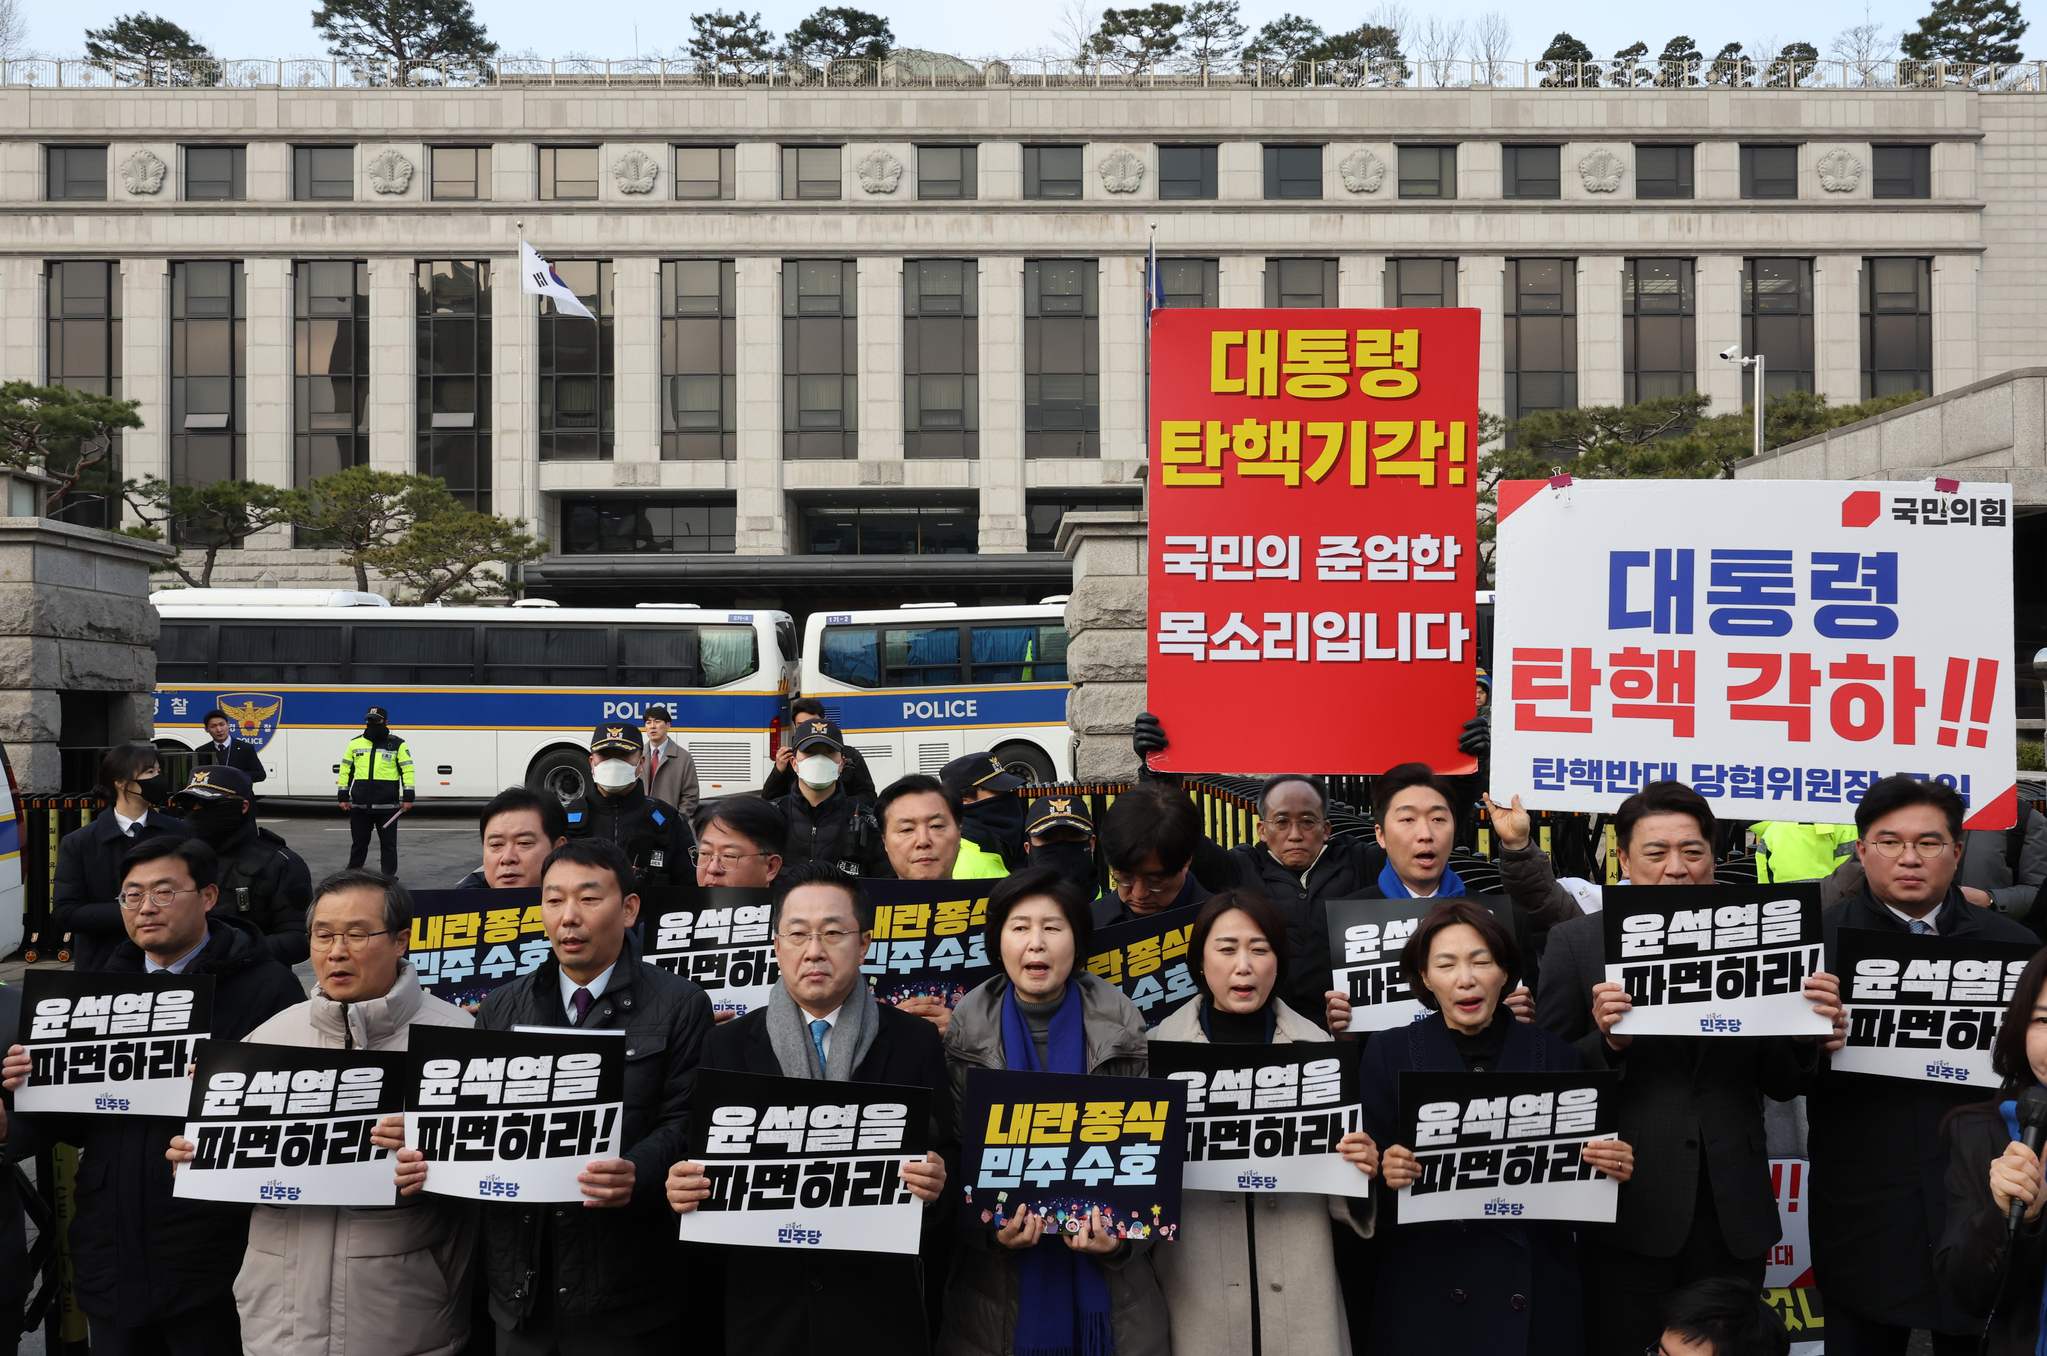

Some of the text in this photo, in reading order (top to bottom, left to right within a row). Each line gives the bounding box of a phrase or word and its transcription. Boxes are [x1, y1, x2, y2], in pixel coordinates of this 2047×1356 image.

[1210, 329, 1419, 398] 대통령
[1161, 418, 1466, 486] 탄핵기각!
[1892, 498, 2006, 527] 국민의힘
[1162, 534, 1461, 581] 국민의 준엄한
[1608, 548, 1899, 640] 대통령
[1157, 612, 1470, 661] 목소리입니다
[903, 699, 978, 720] POLICE
[1511, 646, 2000, 748] 탄핵 각하!!
[409, 912, 482, 950] 내란
[656, 904, 774, 949] 윤석열
[1621, 899, 1802, 958] 윤석열을
[409, 948, 476, 985] 민주
[30, 990, 194, 1039] 윤석열을
[1700, 1018, 1742, 1032] 민주당
[201, 1067, 384, 1116] 윤석열을
[418, 1053, 602, 1105] 윤석열을
[1926, 1064, 1970, 1081] 민주당
[95, 1097, 130, 1111] 민주당
[984, 1101, 1169, 1144] 내란 종식
[1415, 1088, 1598, 1147] 윤석열을
[416, 1107, 618, 1161] 파면하라!
[706, 1103, 908, 1153] 윤석열을
[54, 1147, 67, 1219] LICE
[977, 1143, 1161, 1188] 민주 수호
[1237, 1175, 1277, 1189] 민주당
[260, 1185, 301, 1200] 민주당
[479, 1180, 520, 1198] 민주당
[1484, 1203, 1525, 1216] 민주당
[778, 1228, 822, 1245] 민주당
